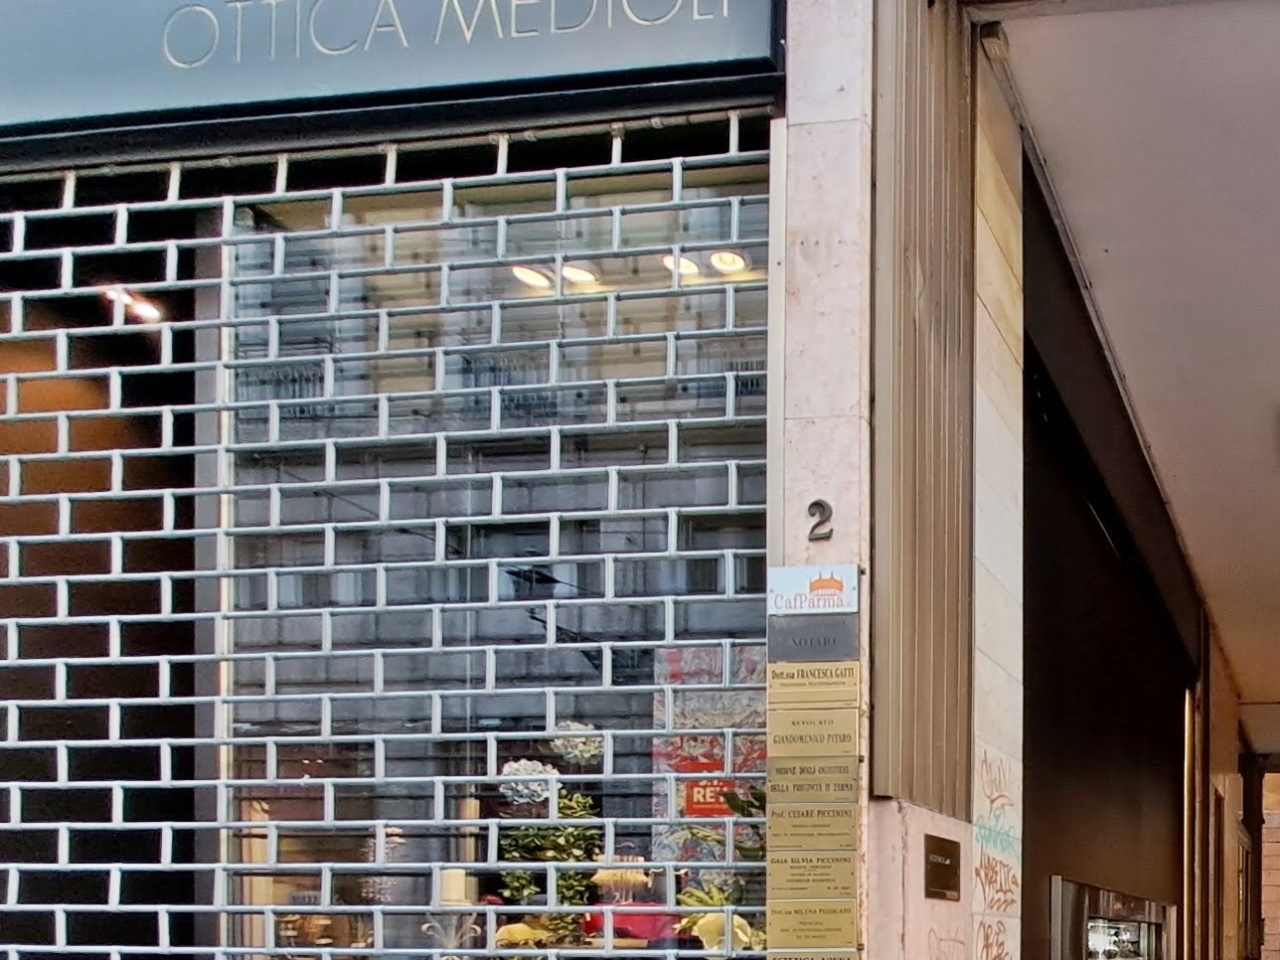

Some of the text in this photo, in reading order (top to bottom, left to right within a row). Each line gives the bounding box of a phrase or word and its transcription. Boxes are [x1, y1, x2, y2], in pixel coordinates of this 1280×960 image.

[163, 0, 410, 68] OTTICA
[807, 499, 834, 542] 2
[791, 719, 835, 727] AVVOCATO
